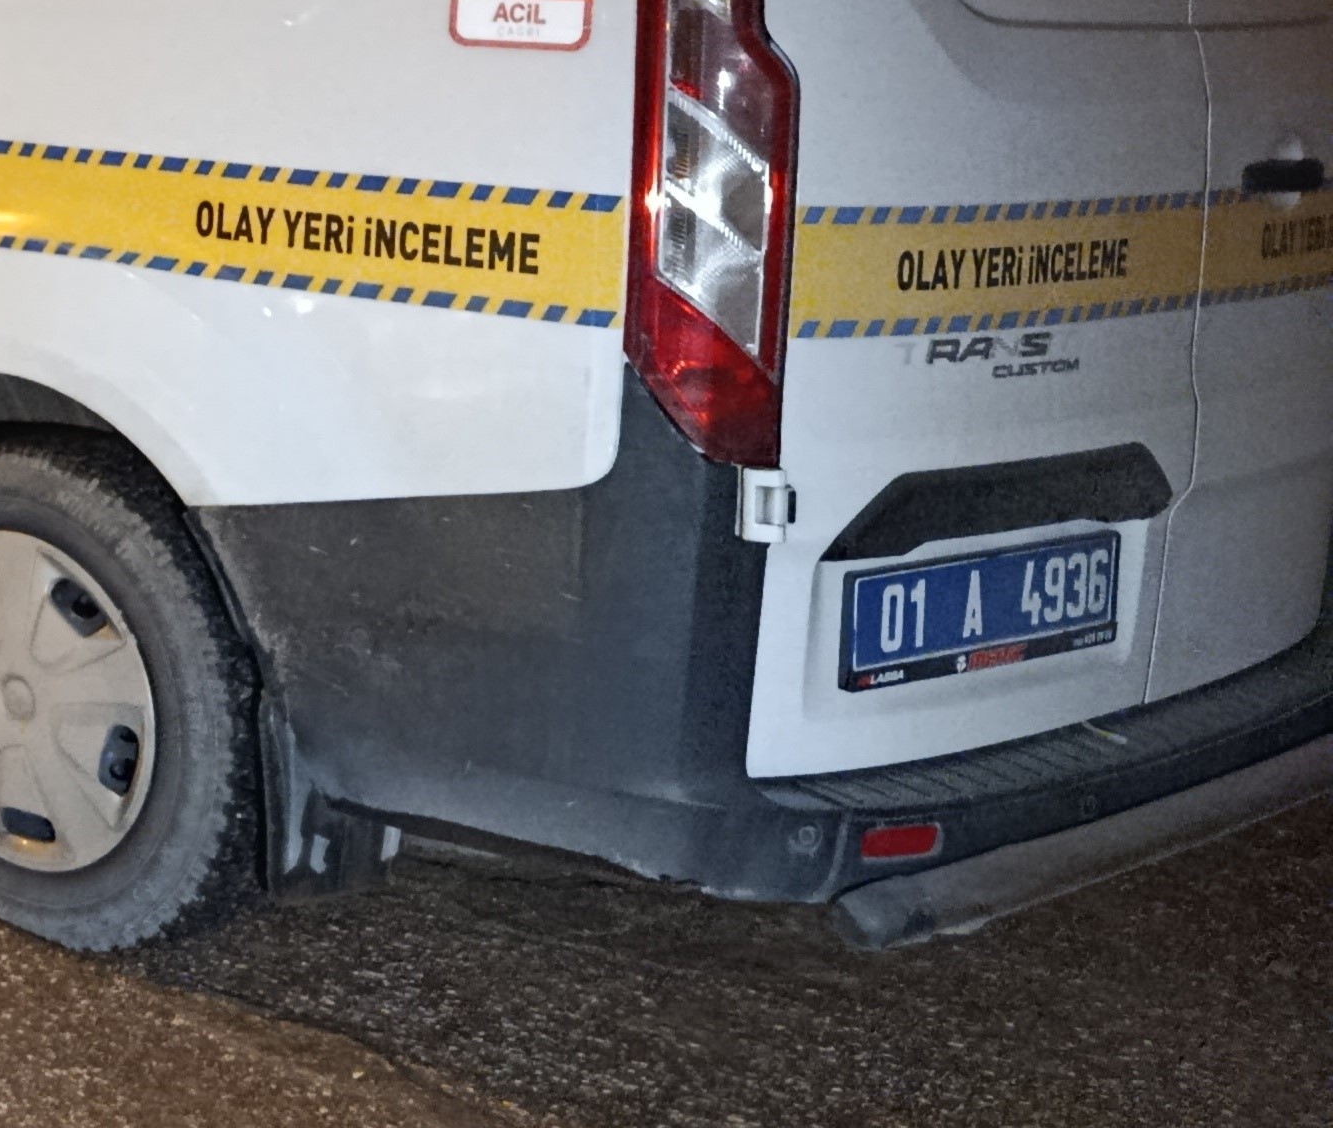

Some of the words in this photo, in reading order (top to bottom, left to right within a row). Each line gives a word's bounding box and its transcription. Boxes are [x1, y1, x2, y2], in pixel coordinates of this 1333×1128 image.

[196, 200, 275, 245] OLAY
[897, 249, 966, 291] OLAY
[992, 358, 1079, 379] CUSTOM
[880, 578, 926, 653] 01
[963, 570, 983, 638] A
[1021, 549, 1109, 626] 4936
